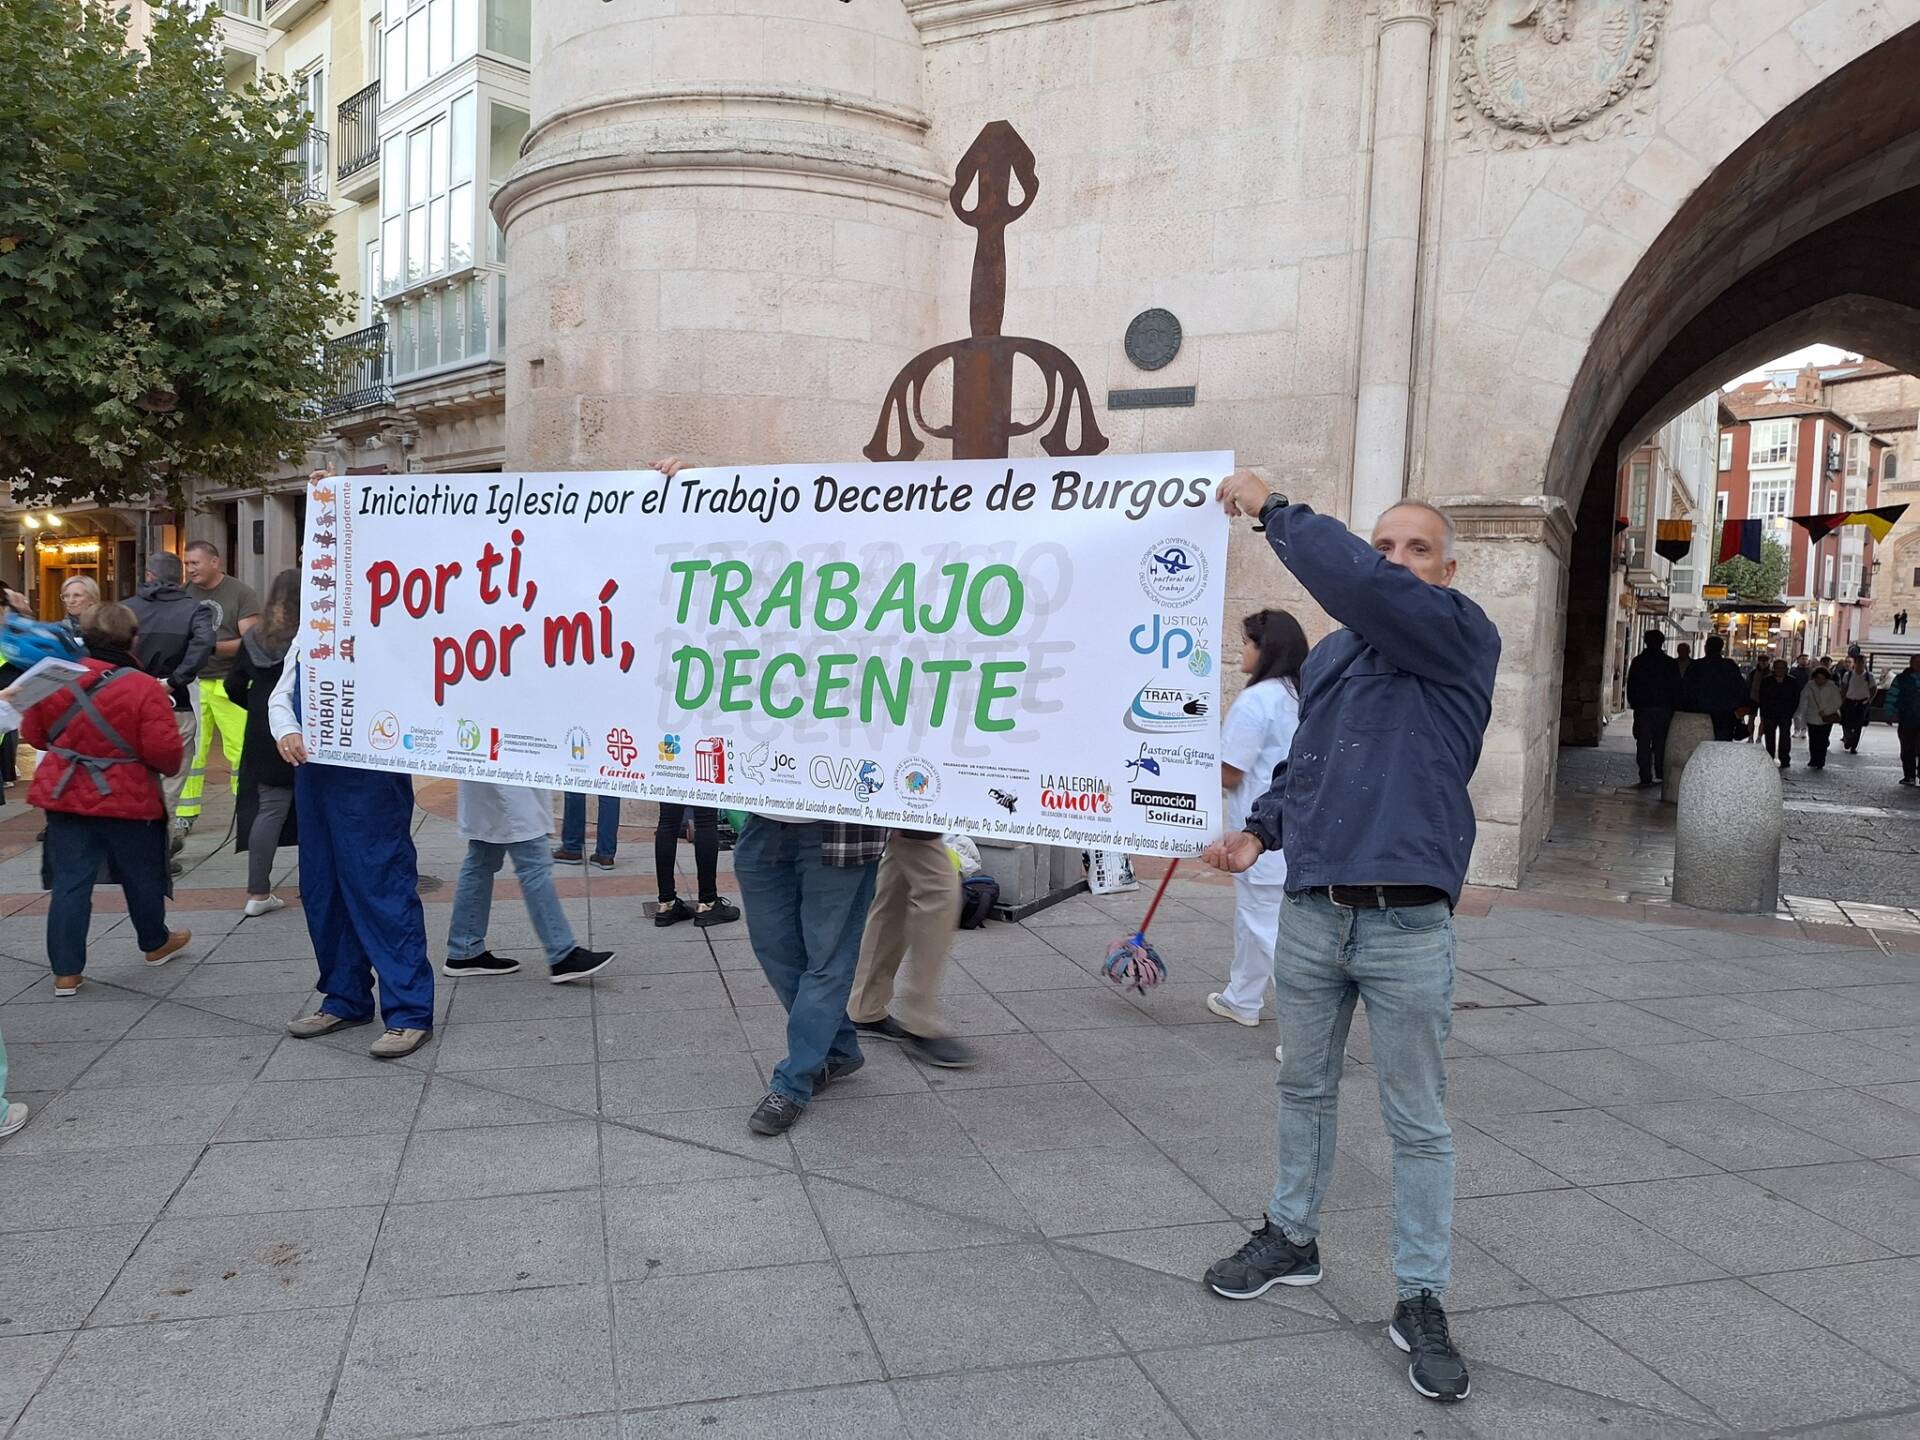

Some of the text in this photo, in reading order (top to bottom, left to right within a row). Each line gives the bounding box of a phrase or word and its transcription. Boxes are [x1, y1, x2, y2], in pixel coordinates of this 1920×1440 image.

[358, 469, 1212, 524] Iniciativa Iglesia por el Trabajo Decente de Burgos
[476, 529, 538, 612] ti,
[670, 559, 1025, 637] TRABAJO
[432, 578, 635, 707] por mí,
[320, 680, 338, 747] TRABAJO
[339, 679, 355, 747] DECENTE
[671, 644, 1026, 732] DECENTE
[1144, 690, 1183, 701] TRATA
[600, 765, 646, 780] Cáritas
[1041, 774, 1104, 793] LA ALEGRÍA
[1041, 790, 1105, 813] amor
[1133, 791, 1195, 809] Promoción
[689, 787, 695, 799] de
[765, 795, 795, 809] Promoción
[796, 798, 804, 810] del
[828, 806, 835, 814] en
[876, 808, 901, 820] Nuestra
[932, 812, 947, 826] Real
[947, 819, 953, 831] y
[995, 820, 1008, 833] San
[1008, 822, 1025, 835] Juan
[1026, 822, 1035, 836] de
[1063, 827, 1111, 846] Congregación
[1113, 831, 1121, 845] de
[1160, 836, 1169, 850] de
[1148, 810, 1203, 826] Solidaria
